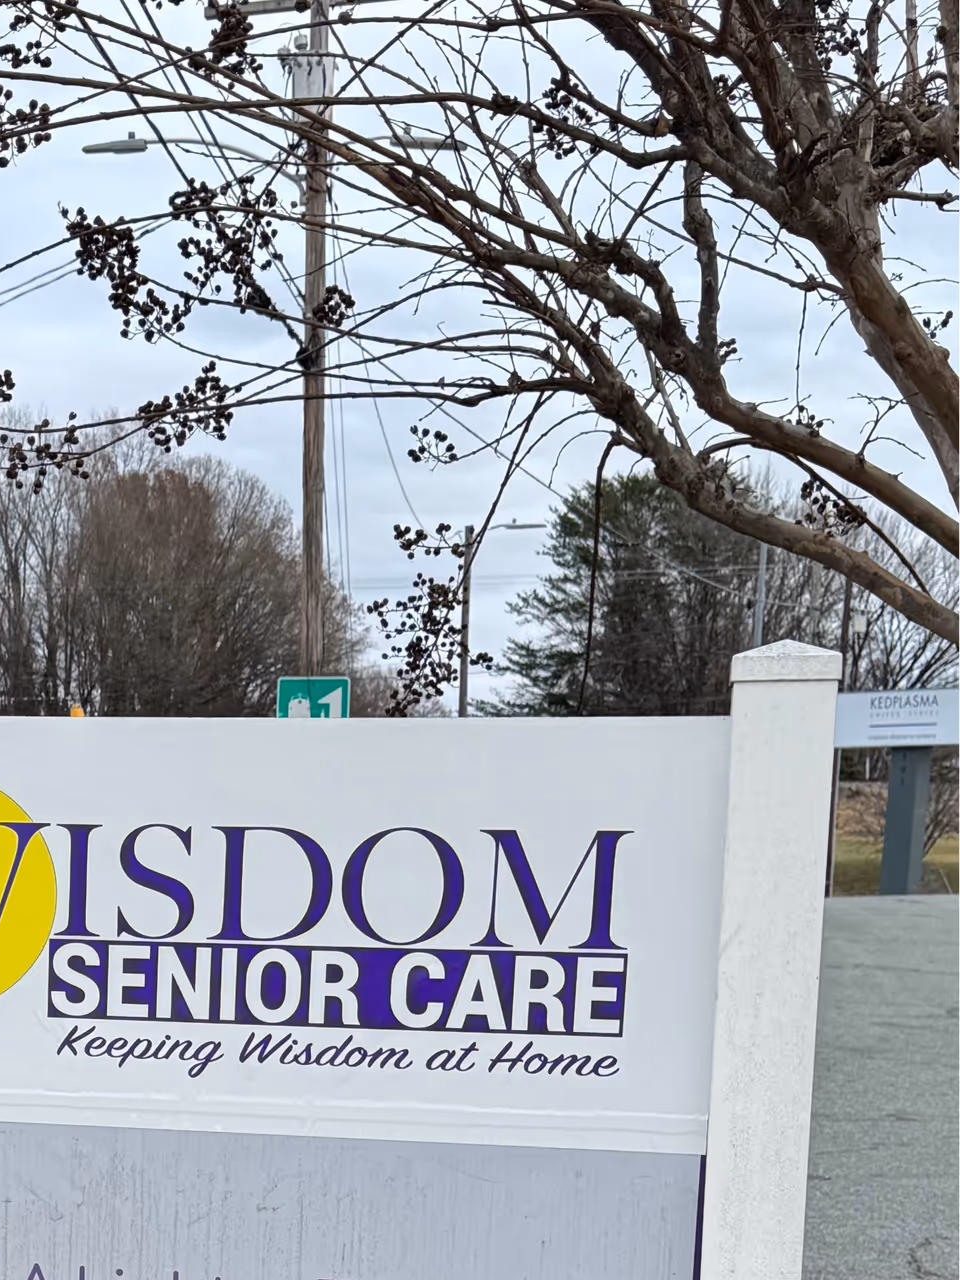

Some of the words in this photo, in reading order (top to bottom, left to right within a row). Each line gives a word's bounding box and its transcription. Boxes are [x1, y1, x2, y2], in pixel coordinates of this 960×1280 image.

[870, 694, 939, 710] KEDPLASMA
[50, 943, 361, 1025] SENIOR
[388, 951, 625, 1033] CARE
[55, 1023, 224, 1079] Keeping
[238, 1032, 413, 1070] Wisdom
[426, 1041, 477, 1073] at
[487, 1041, 620, 1078] Home
